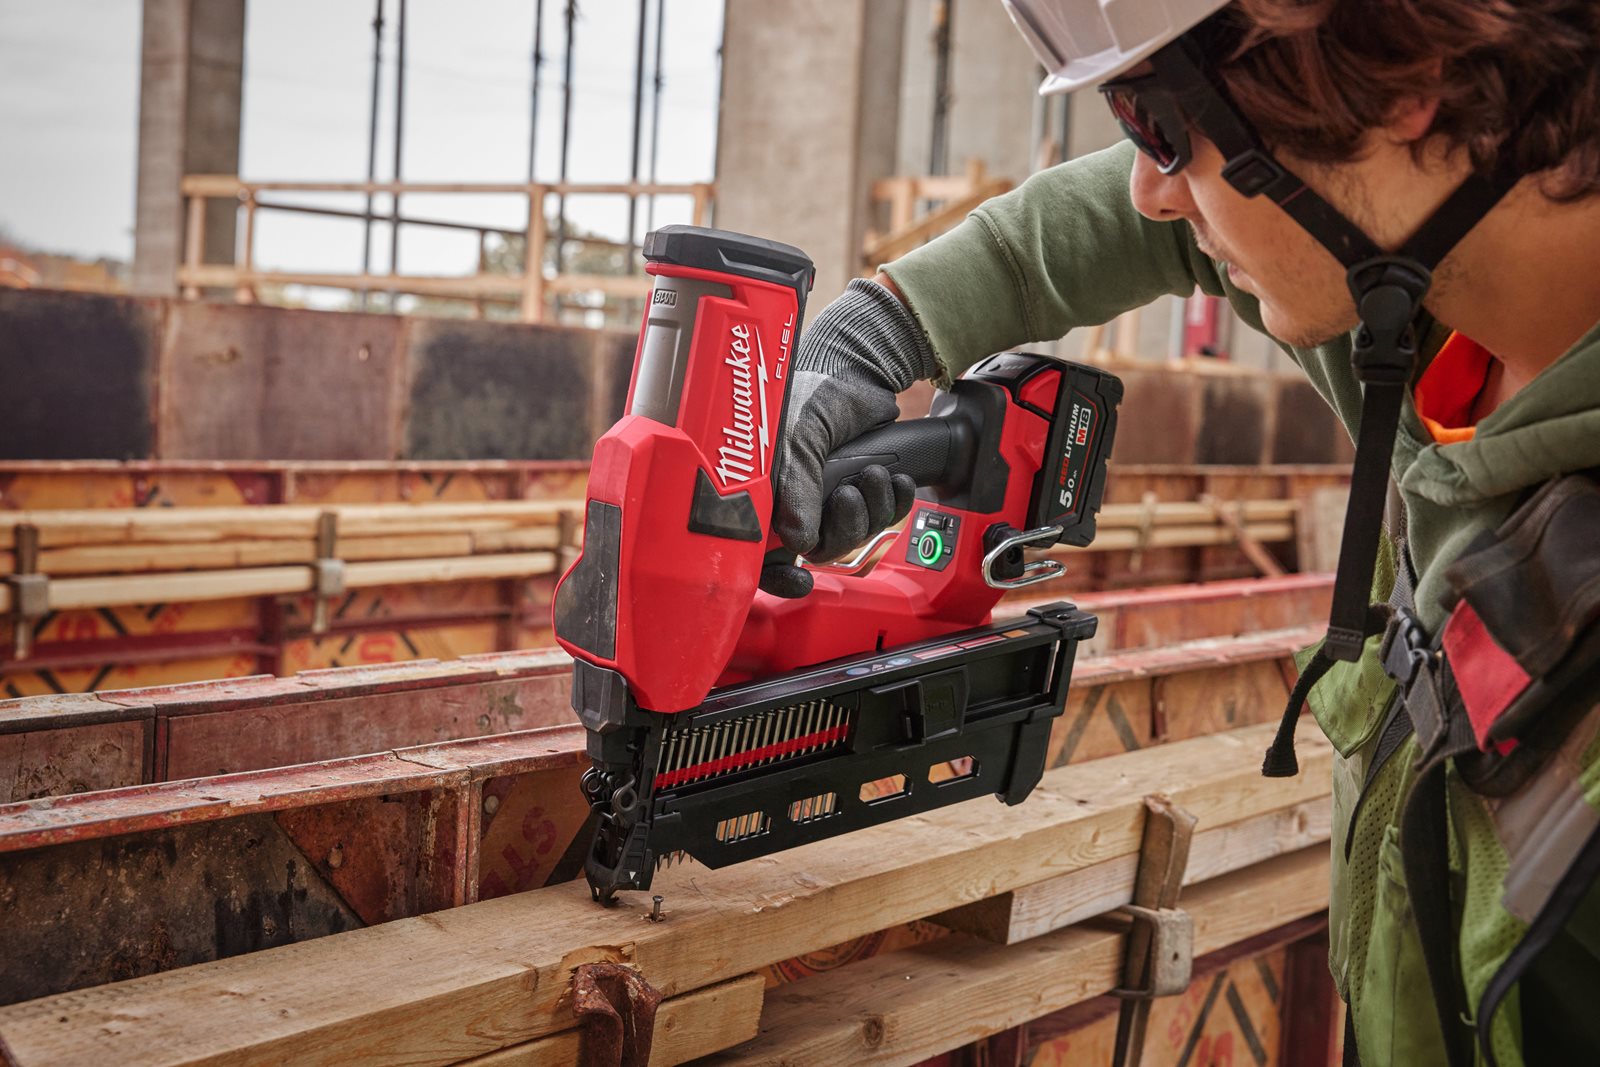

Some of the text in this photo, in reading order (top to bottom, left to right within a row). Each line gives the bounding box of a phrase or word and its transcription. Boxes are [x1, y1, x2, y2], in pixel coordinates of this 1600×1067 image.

[775, 313, 793, 379] FUEL
[715, 323, 755, 486] Milwaukee
[1076, 408, 1091, 445] M18
[1060, 403, 1080, 486] REDLITHIUM
